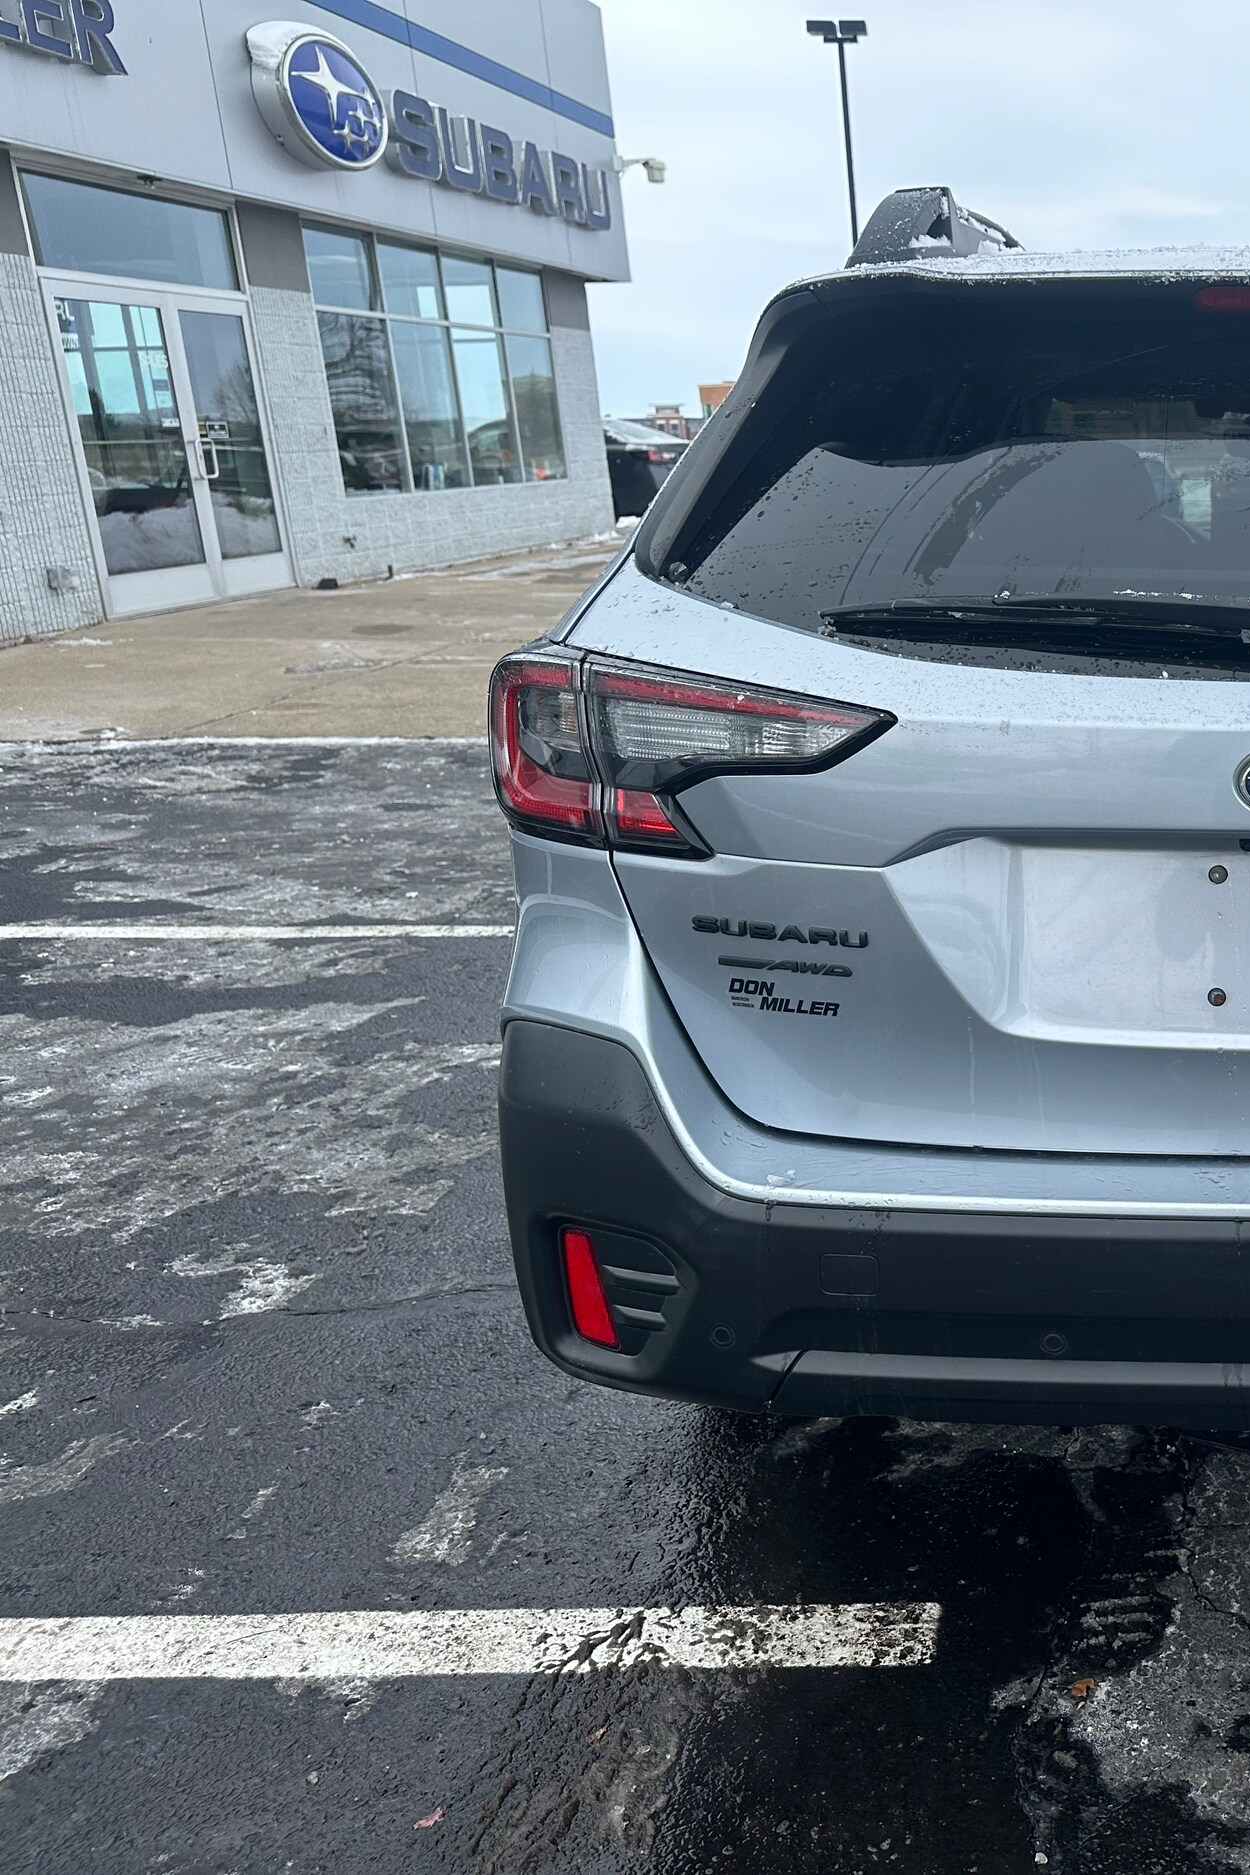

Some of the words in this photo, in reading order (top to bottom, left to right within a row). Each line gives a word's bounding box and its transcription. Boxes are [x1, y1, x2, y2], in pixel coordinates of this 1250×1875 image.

[0, 0, 128, 76] ER
[389, 88, 612, 232] SUBARU
[691, 914, 869, 949] SUBARU
[766, 959, 853, 978] AWD
[728, 977, 776, 997] DON
[759, 996, 841, 1017] MILLER
